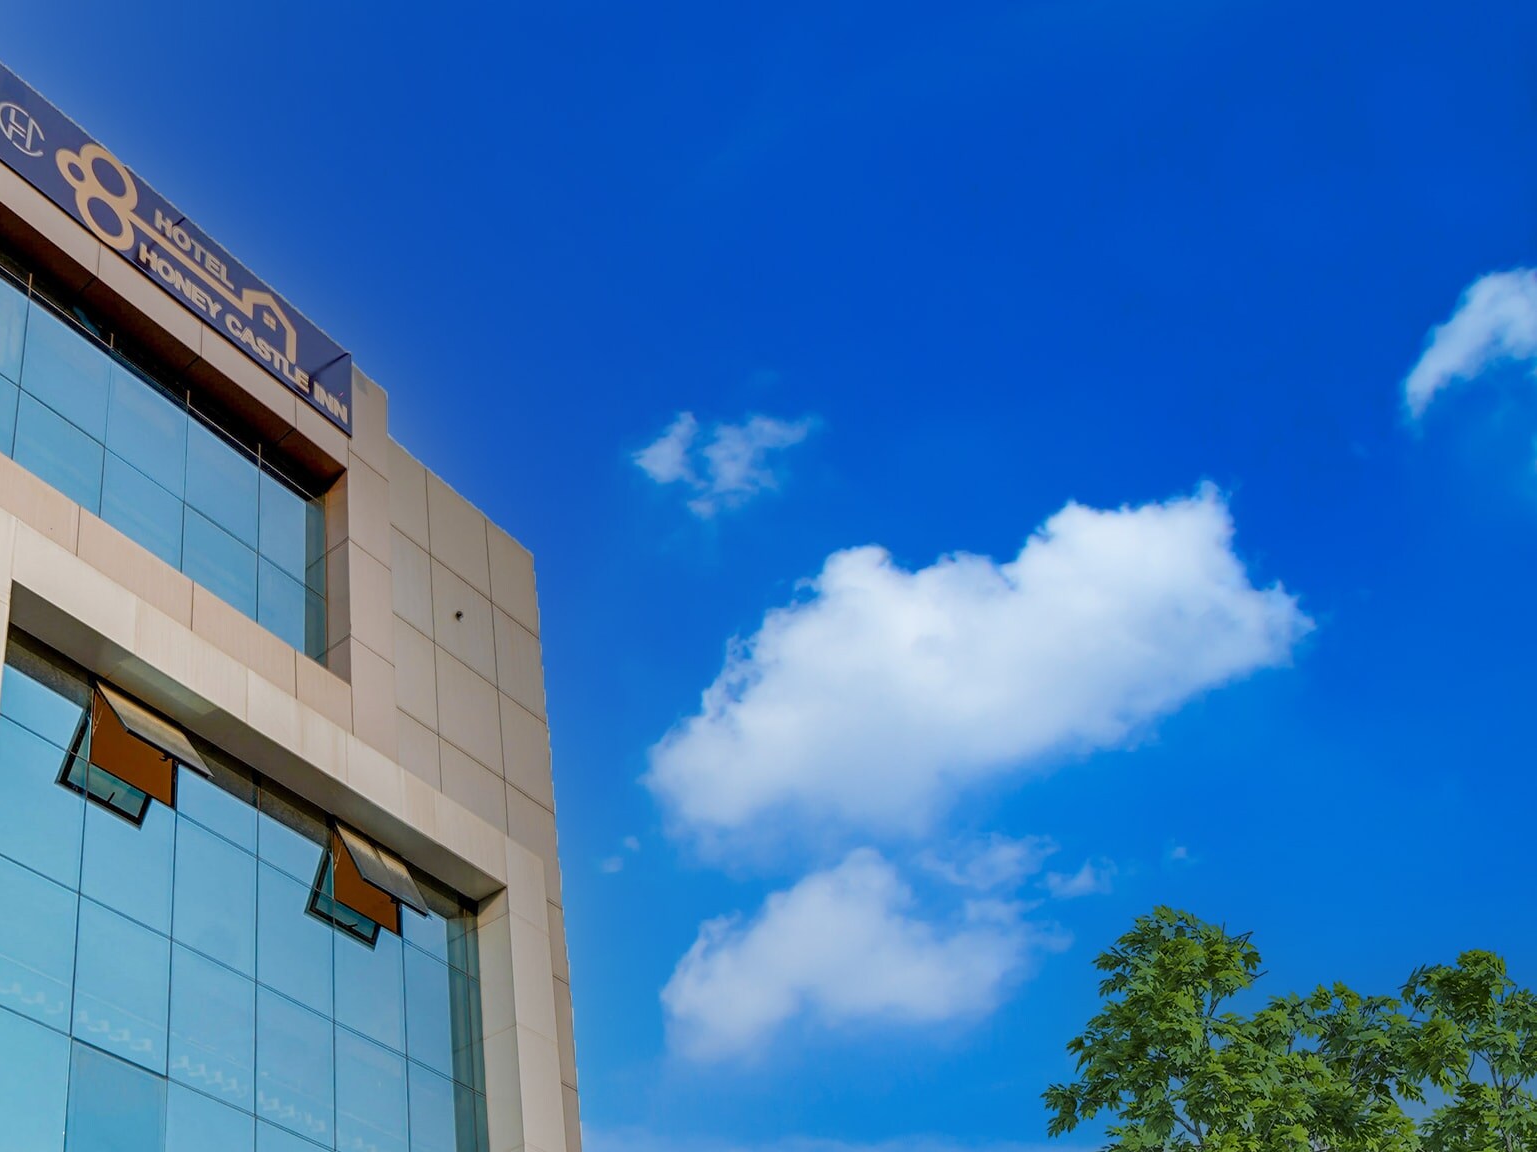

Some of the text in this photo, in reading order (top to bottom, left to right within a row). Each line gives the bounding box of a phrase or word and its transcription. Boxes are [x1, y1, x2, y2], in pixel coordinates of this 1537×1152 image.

[153, 208, 235, 290] HOTEL
[138, 243, 349, 425] HONEY CASTLE INN
